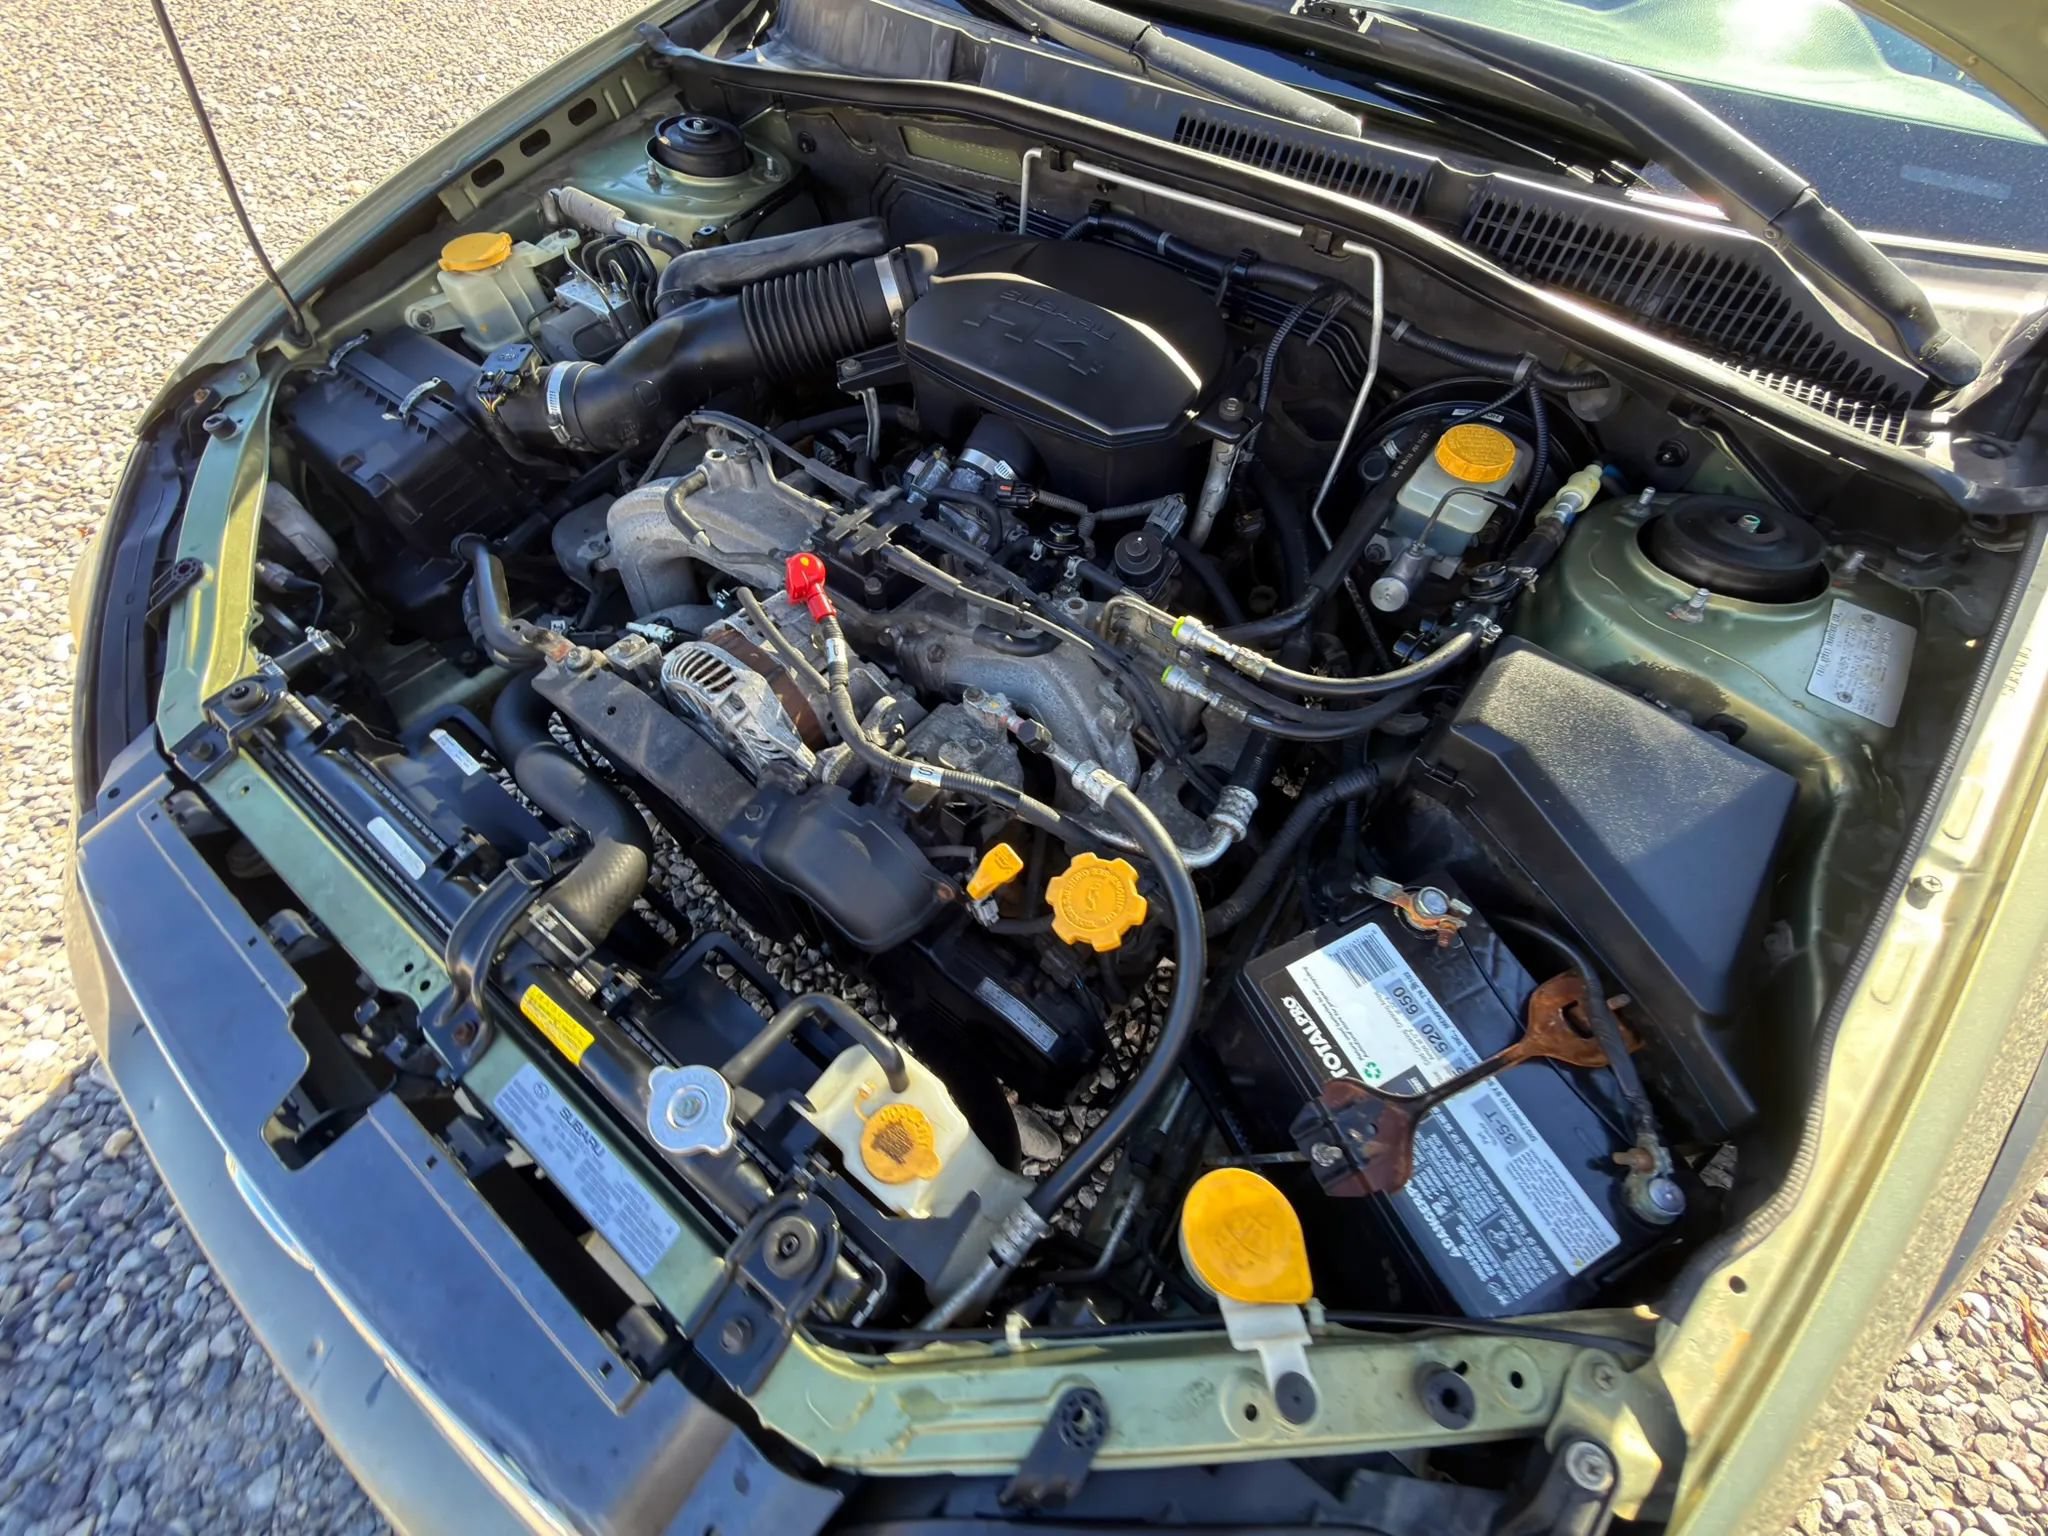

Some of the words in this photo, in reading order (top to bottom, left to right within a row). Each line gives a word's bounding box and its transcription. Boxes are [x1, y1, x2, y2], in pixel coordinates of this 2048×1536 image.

[1390, 985, 1420, 1016] 650
[1278, 991, 1350, 1080] TOTALPRO
[1418, 1022, 1450, 1054] 520
[557, 1105, 607, 1159] SUBARU
[1483, 1107, 1518, 1146] 35-T
